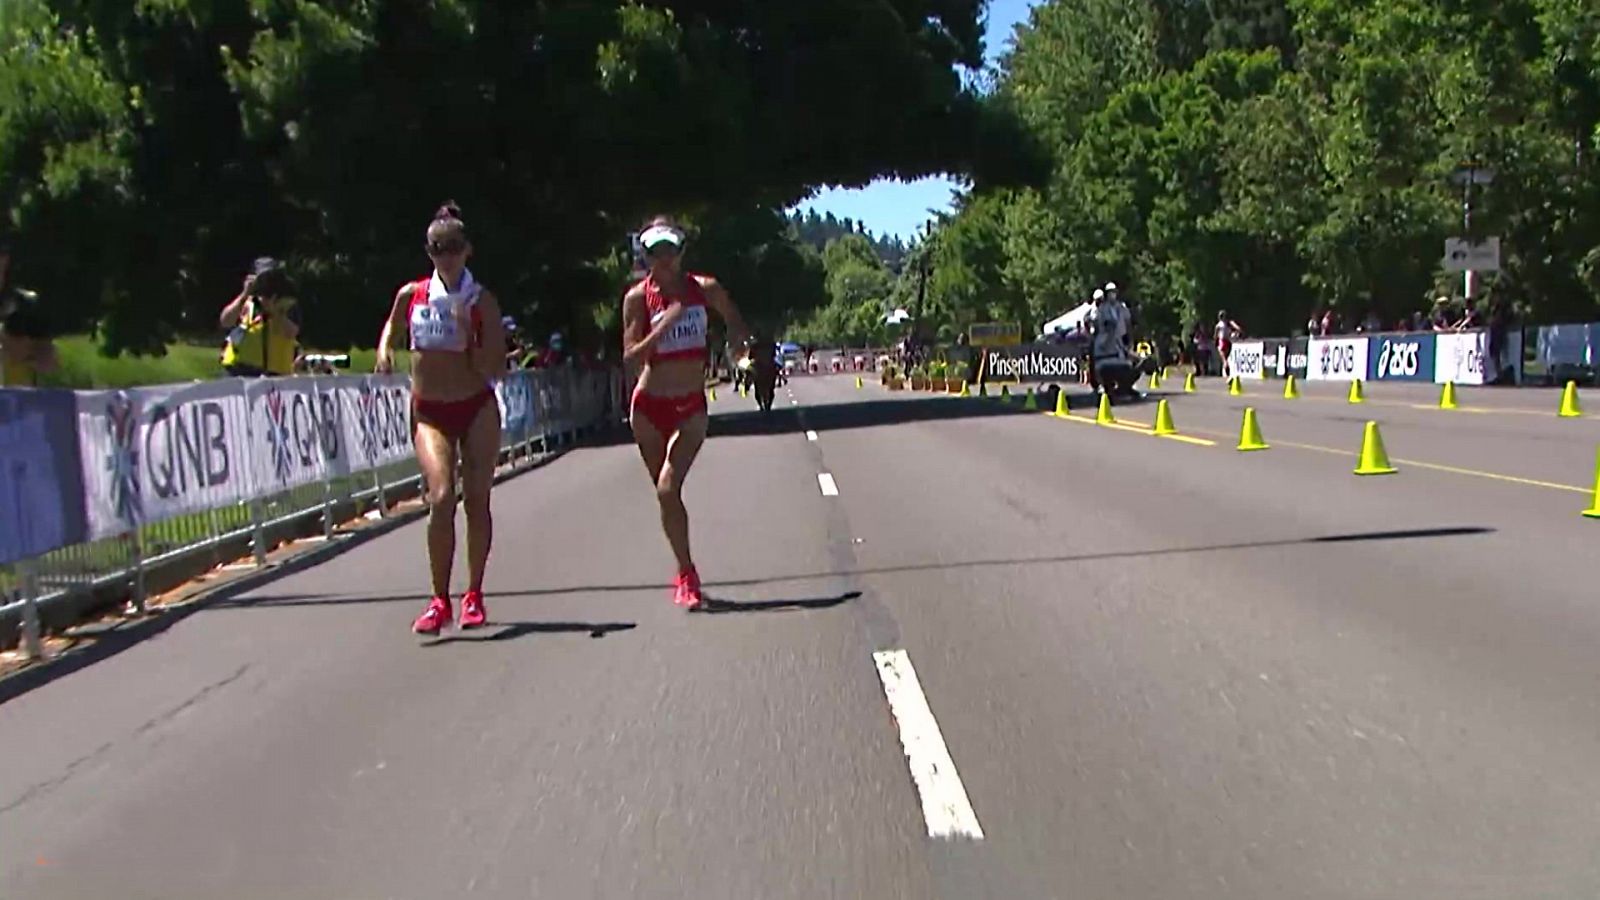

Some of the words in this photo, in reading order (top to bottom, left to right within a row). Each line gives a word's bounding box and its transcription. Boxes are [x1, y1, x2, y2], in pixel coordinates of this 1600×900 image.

[989, 352, 1028, 376] Pinsent
[1030, 351, 1078, 376] Masons
[1234, 347, 1260, 374] Nielsen
[1332, 344, 1354, 373] QNB
[292, 392, 338, 468] QNB
[374, 388, 408, 450] QNB
[146, 401, 229, 499] QNB
